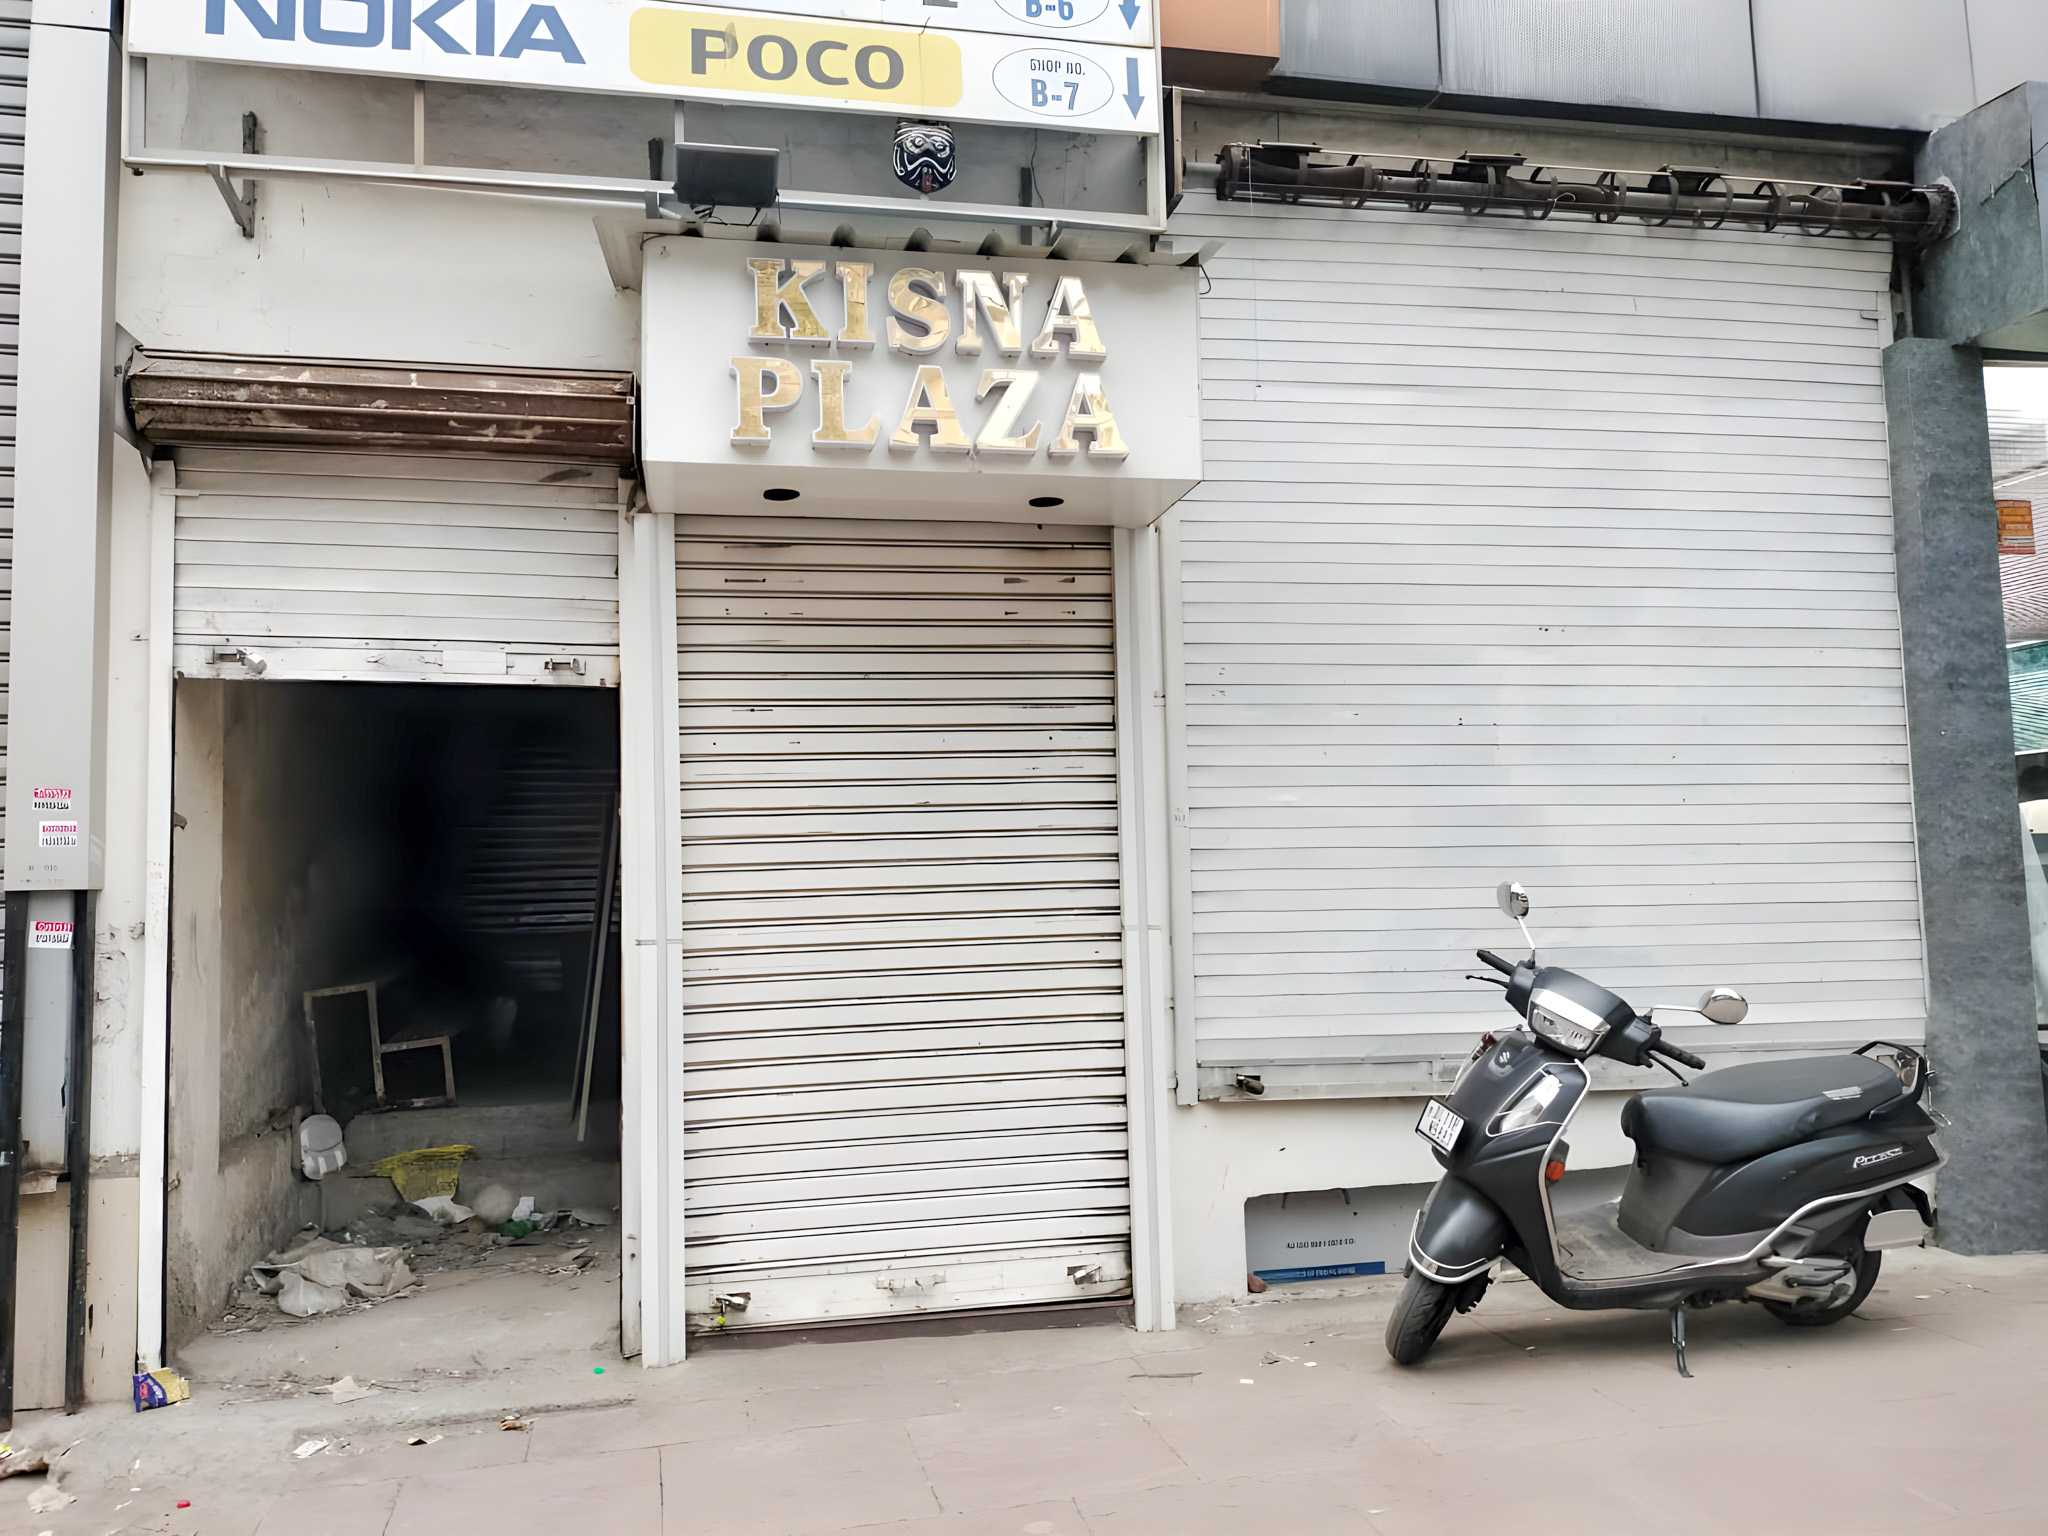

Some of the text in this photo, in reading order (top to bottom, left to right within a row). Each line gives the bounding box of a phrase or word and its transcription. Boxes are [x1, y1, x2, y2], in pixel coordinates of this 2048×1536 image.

[205, 0, 586, 65] NOKIA
[690, 28, 905, 90] POCO
[1031, 78, 1079, 111] B-7
[746, 257, 1107, 361] KISNA
[729, 357, 1130, 461] PLAZA
